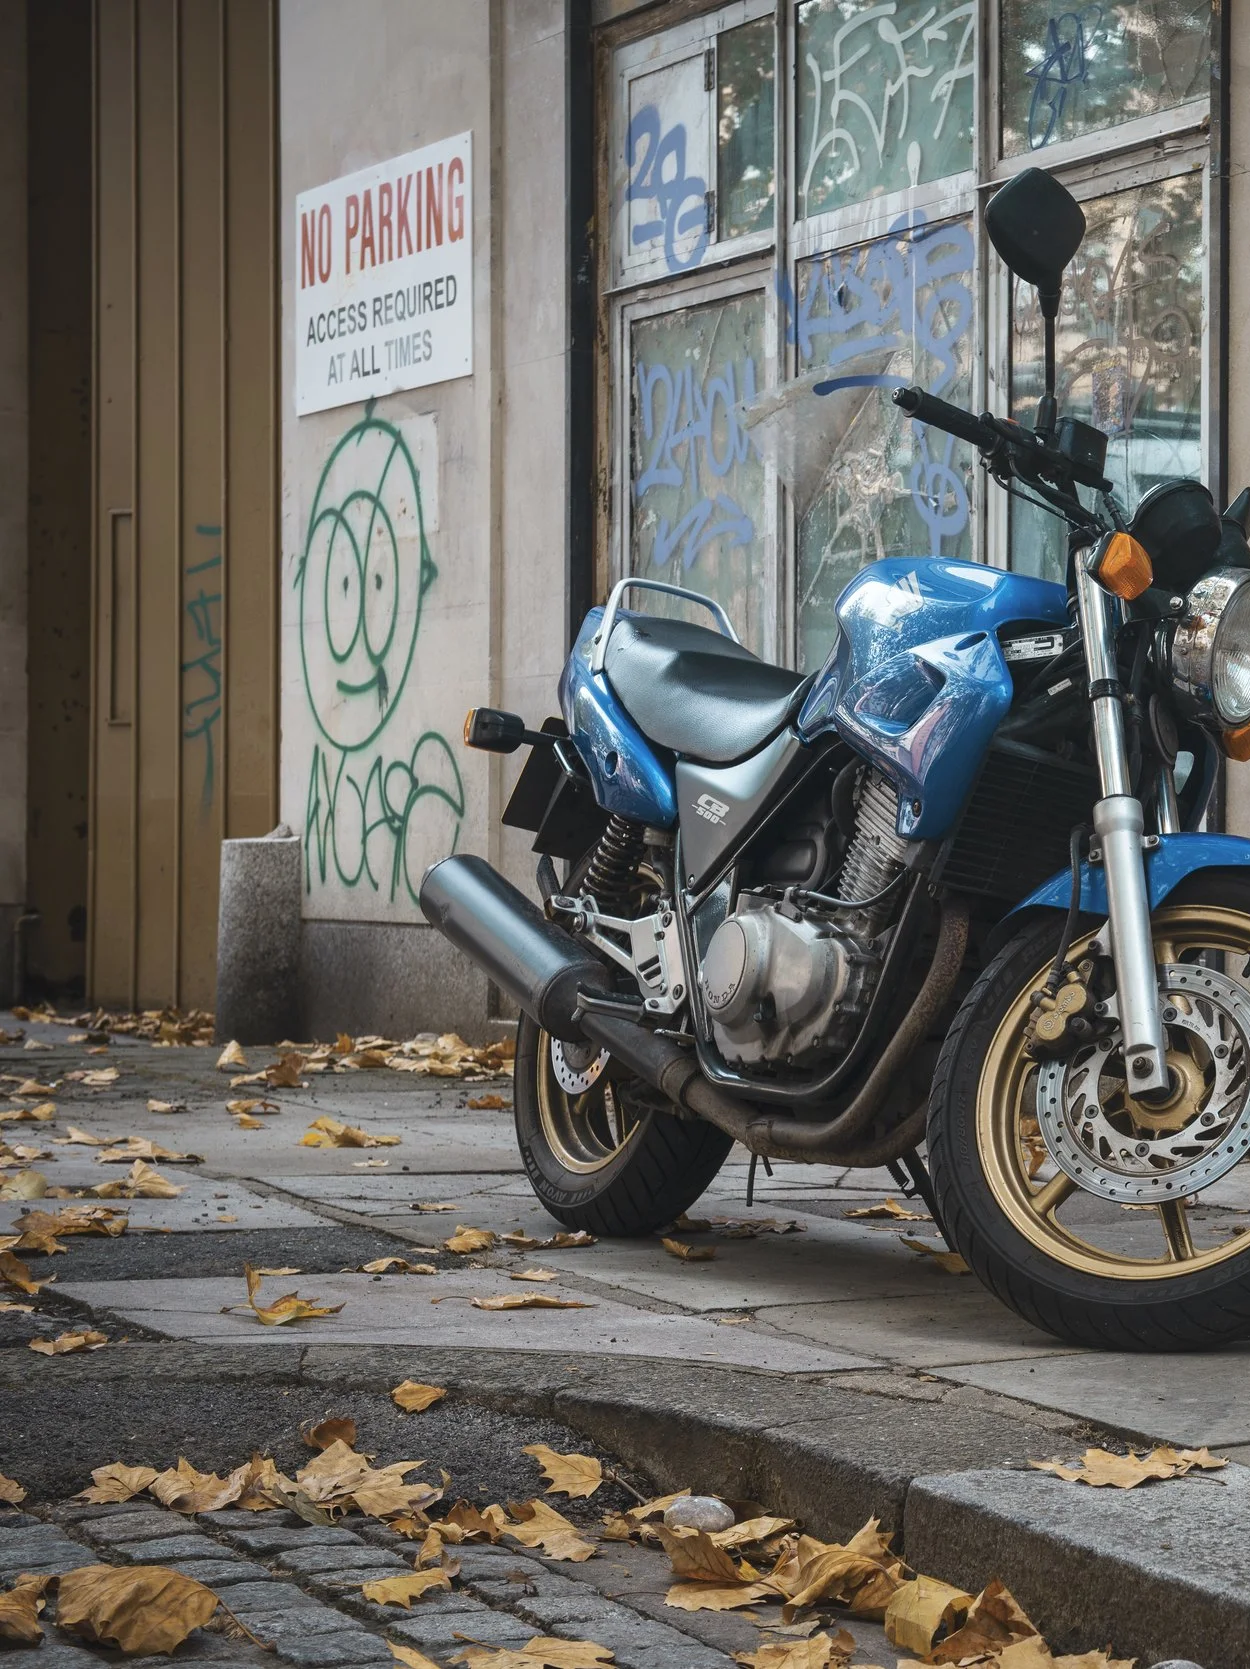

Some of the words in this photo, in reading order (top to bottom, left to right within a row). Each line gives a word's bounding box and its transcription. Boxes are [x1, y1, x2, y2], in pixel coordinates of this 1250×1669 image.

[301, 203, 332, 290] NO
[345, 156, 465, 275] PARKING
[306, 300, 367, 347] ACCESS
[372, 274, 458, 328] REQUIRED
[327, 353, 346, 386] AT
[350, 345, 381, 381] ALL
[384, 329, 433, 371] TIMES
[695, 805, 720, 825] 500
[697, 793, 730, 818] CB
[704, 977, 736, 1004] HONDA
[539, 1179, 567, 1203] AVON
